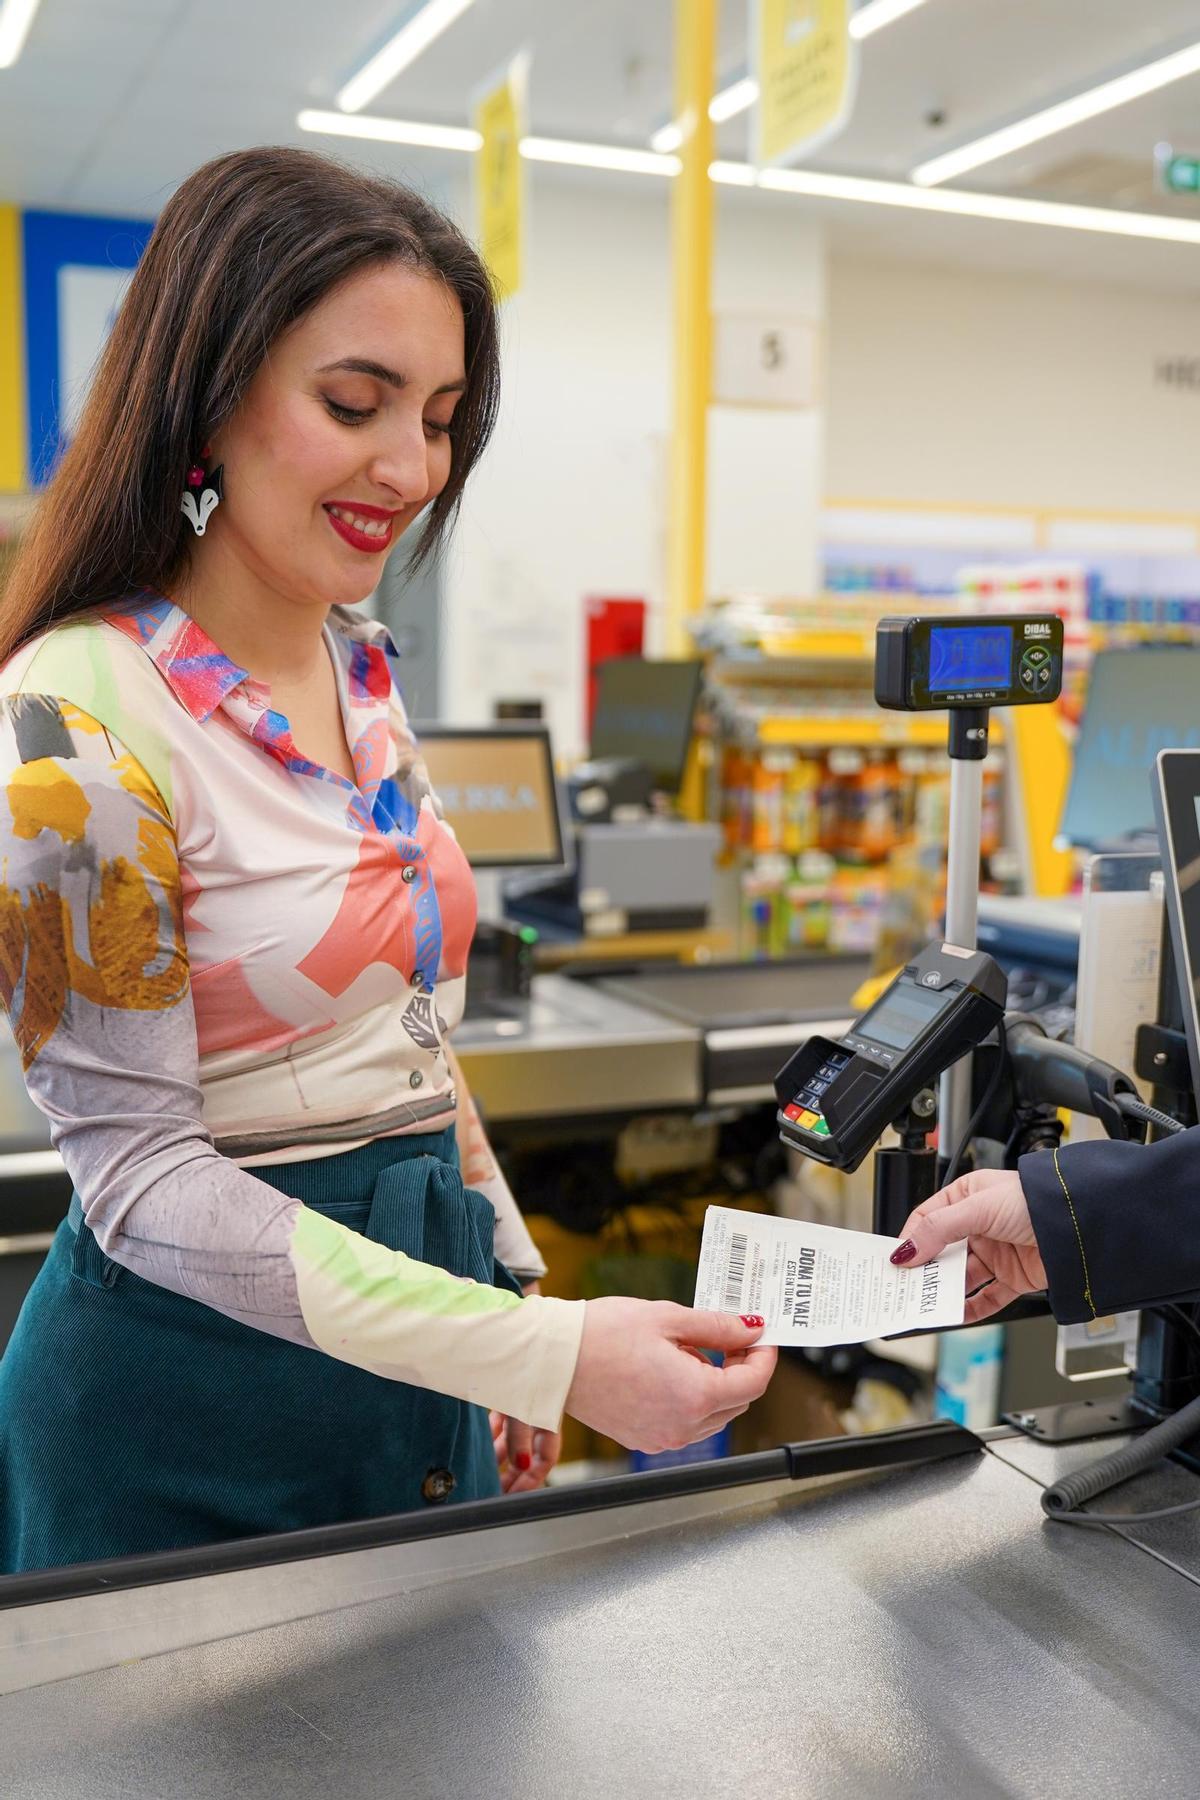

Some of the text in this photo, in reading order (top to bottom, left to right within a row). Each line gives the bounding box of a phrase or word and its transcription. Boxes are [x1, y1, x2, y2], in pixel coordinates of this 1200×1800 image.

[1023, 624, 1051, 634] DIBAL
[785, 1277, 795, 1286] EN
[784, 1288, 795, 1296] TU
[791, 1247, 816, 1328] DONA TU VALE
[782, 1297, 794, 1316] MANO
